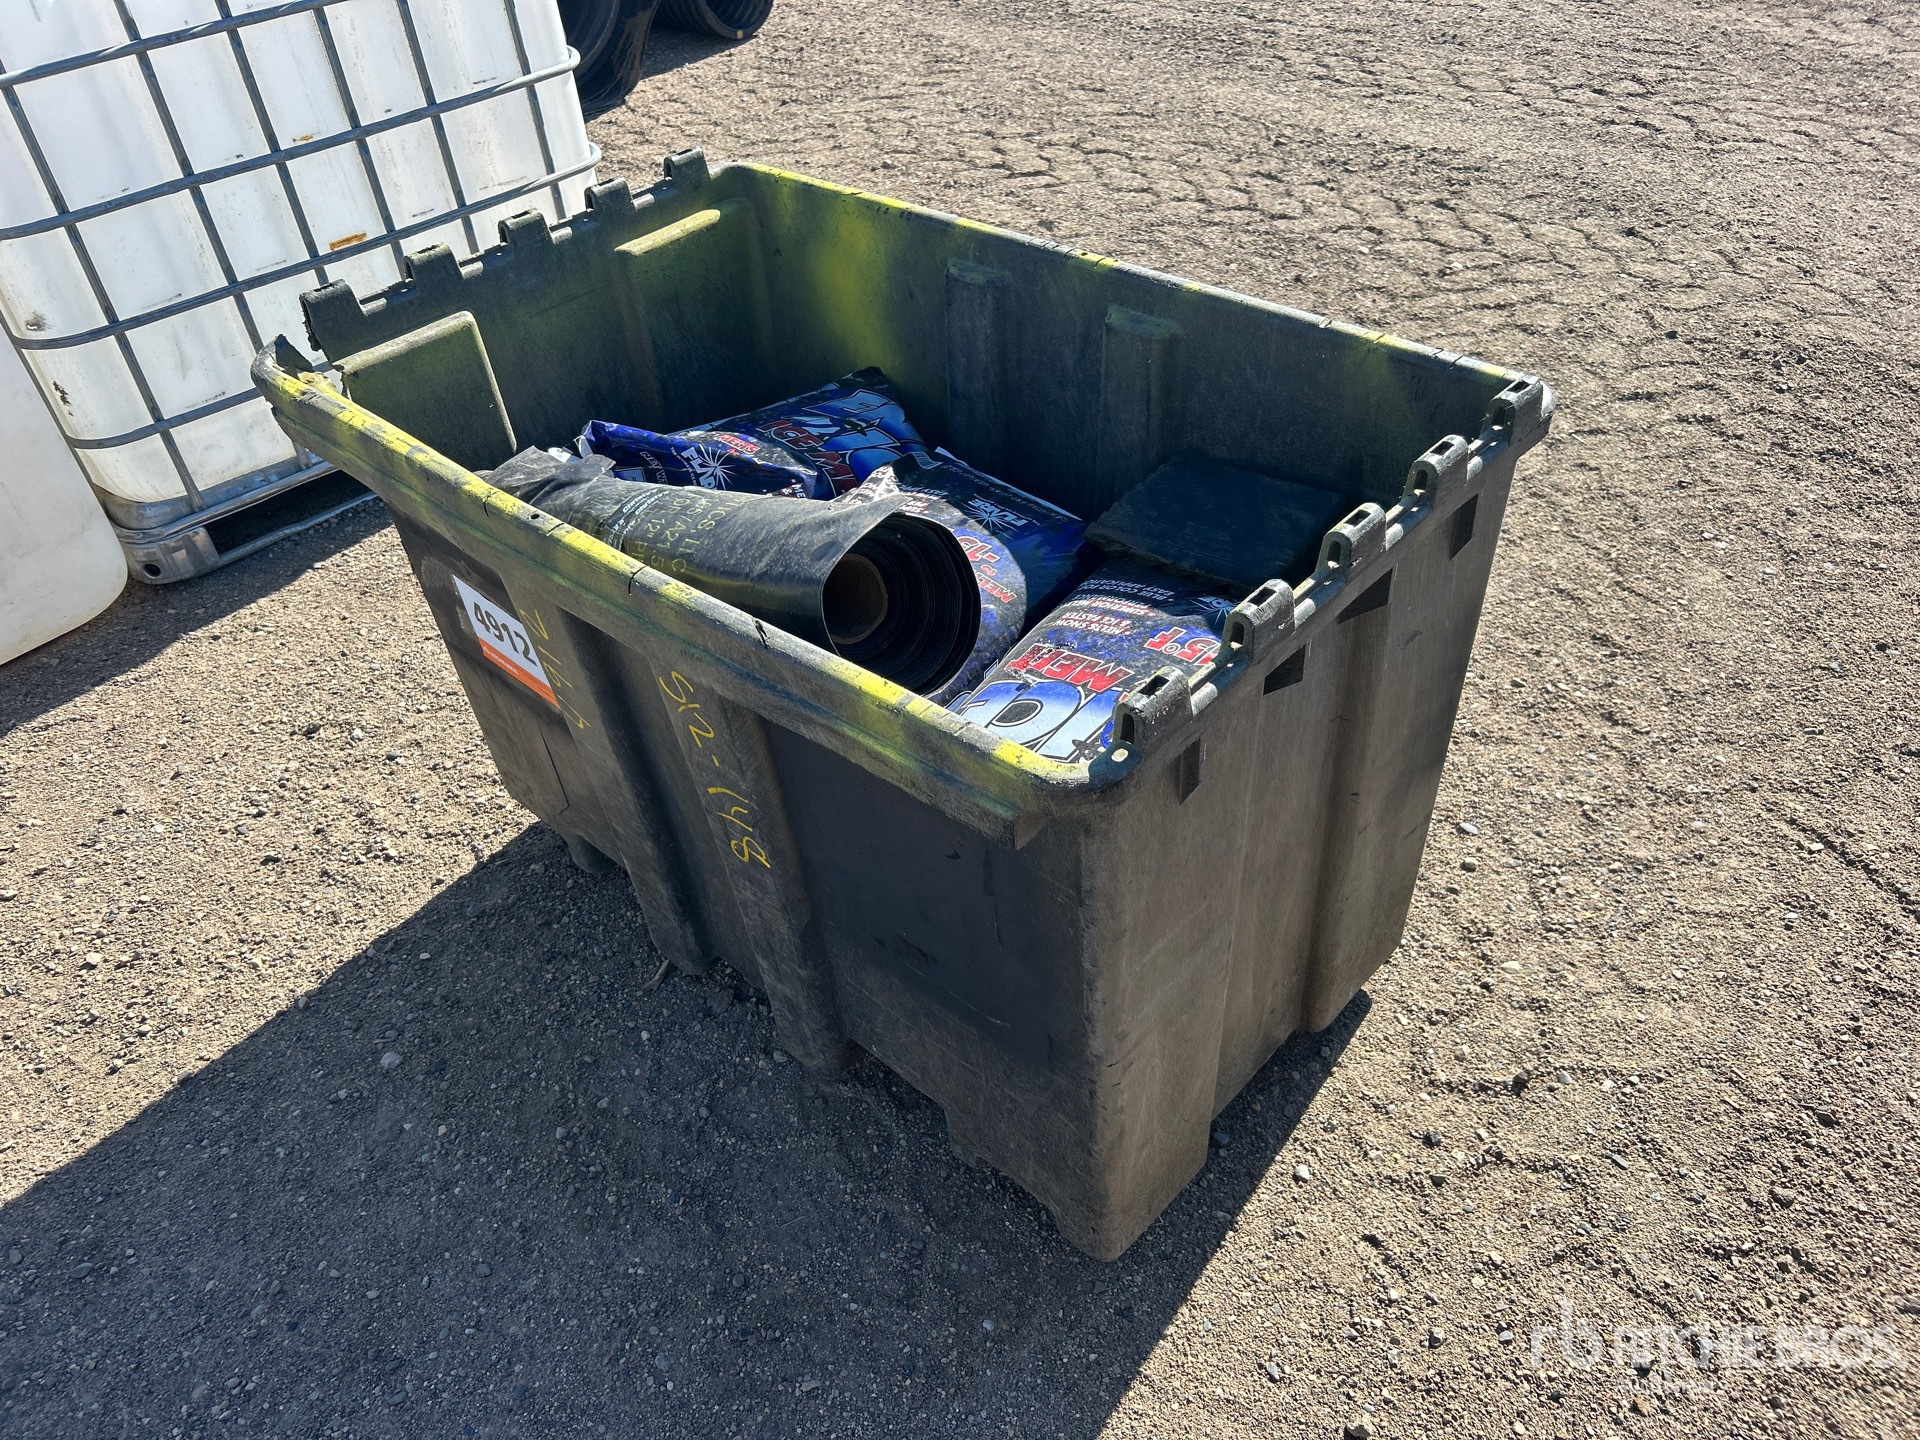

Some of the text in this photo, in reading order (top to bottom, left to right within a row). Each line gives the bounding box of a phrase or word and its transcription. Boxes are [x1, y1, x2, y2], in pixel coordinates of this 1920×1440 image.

[756, 420, 824, 450] ICE
[640, 451, 662, 470] NET
[681, 446, 718, 490] FLAR
[967, 498, 1029, 527] FLARE
[1060, 610, 1102, 621] FASTER
[1091, 600, 1148, 616] SUPERIOR
[473, 601, 538, 667] 4912
[1087, 622, 1125, 635] MELTS
[1004, 643, 1135, 692] MELT
